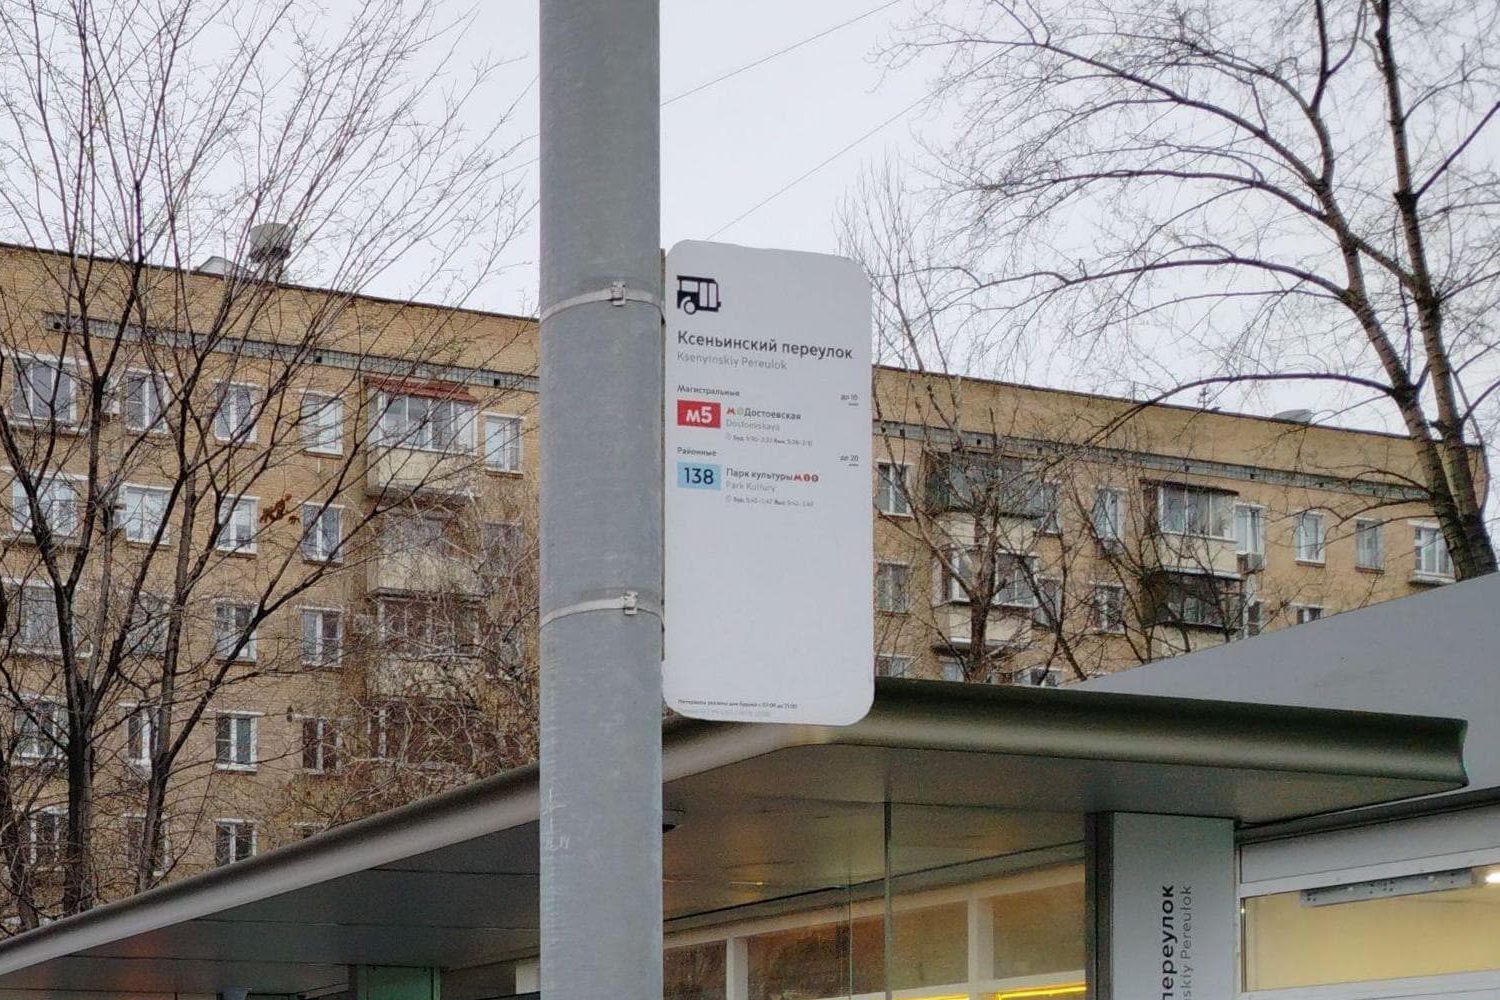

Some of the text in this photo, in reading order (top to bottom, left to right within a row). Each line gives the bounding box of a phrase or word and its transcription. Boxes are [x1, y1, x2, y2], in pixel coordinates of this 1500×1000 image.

[677, 330, 853, 361] Ксеньинский переулок
[742, 357, 788, 370] Pereulok
[744, 407, 801, 420] Достоевская
[677, 446, 717, 457] Районные
[684, 467, 714, 485] 138
[726, 468, 750, 480] Парк
[751, 472, 793, 482] культуры
[1180, 885, 1193, 961] Pereulok
